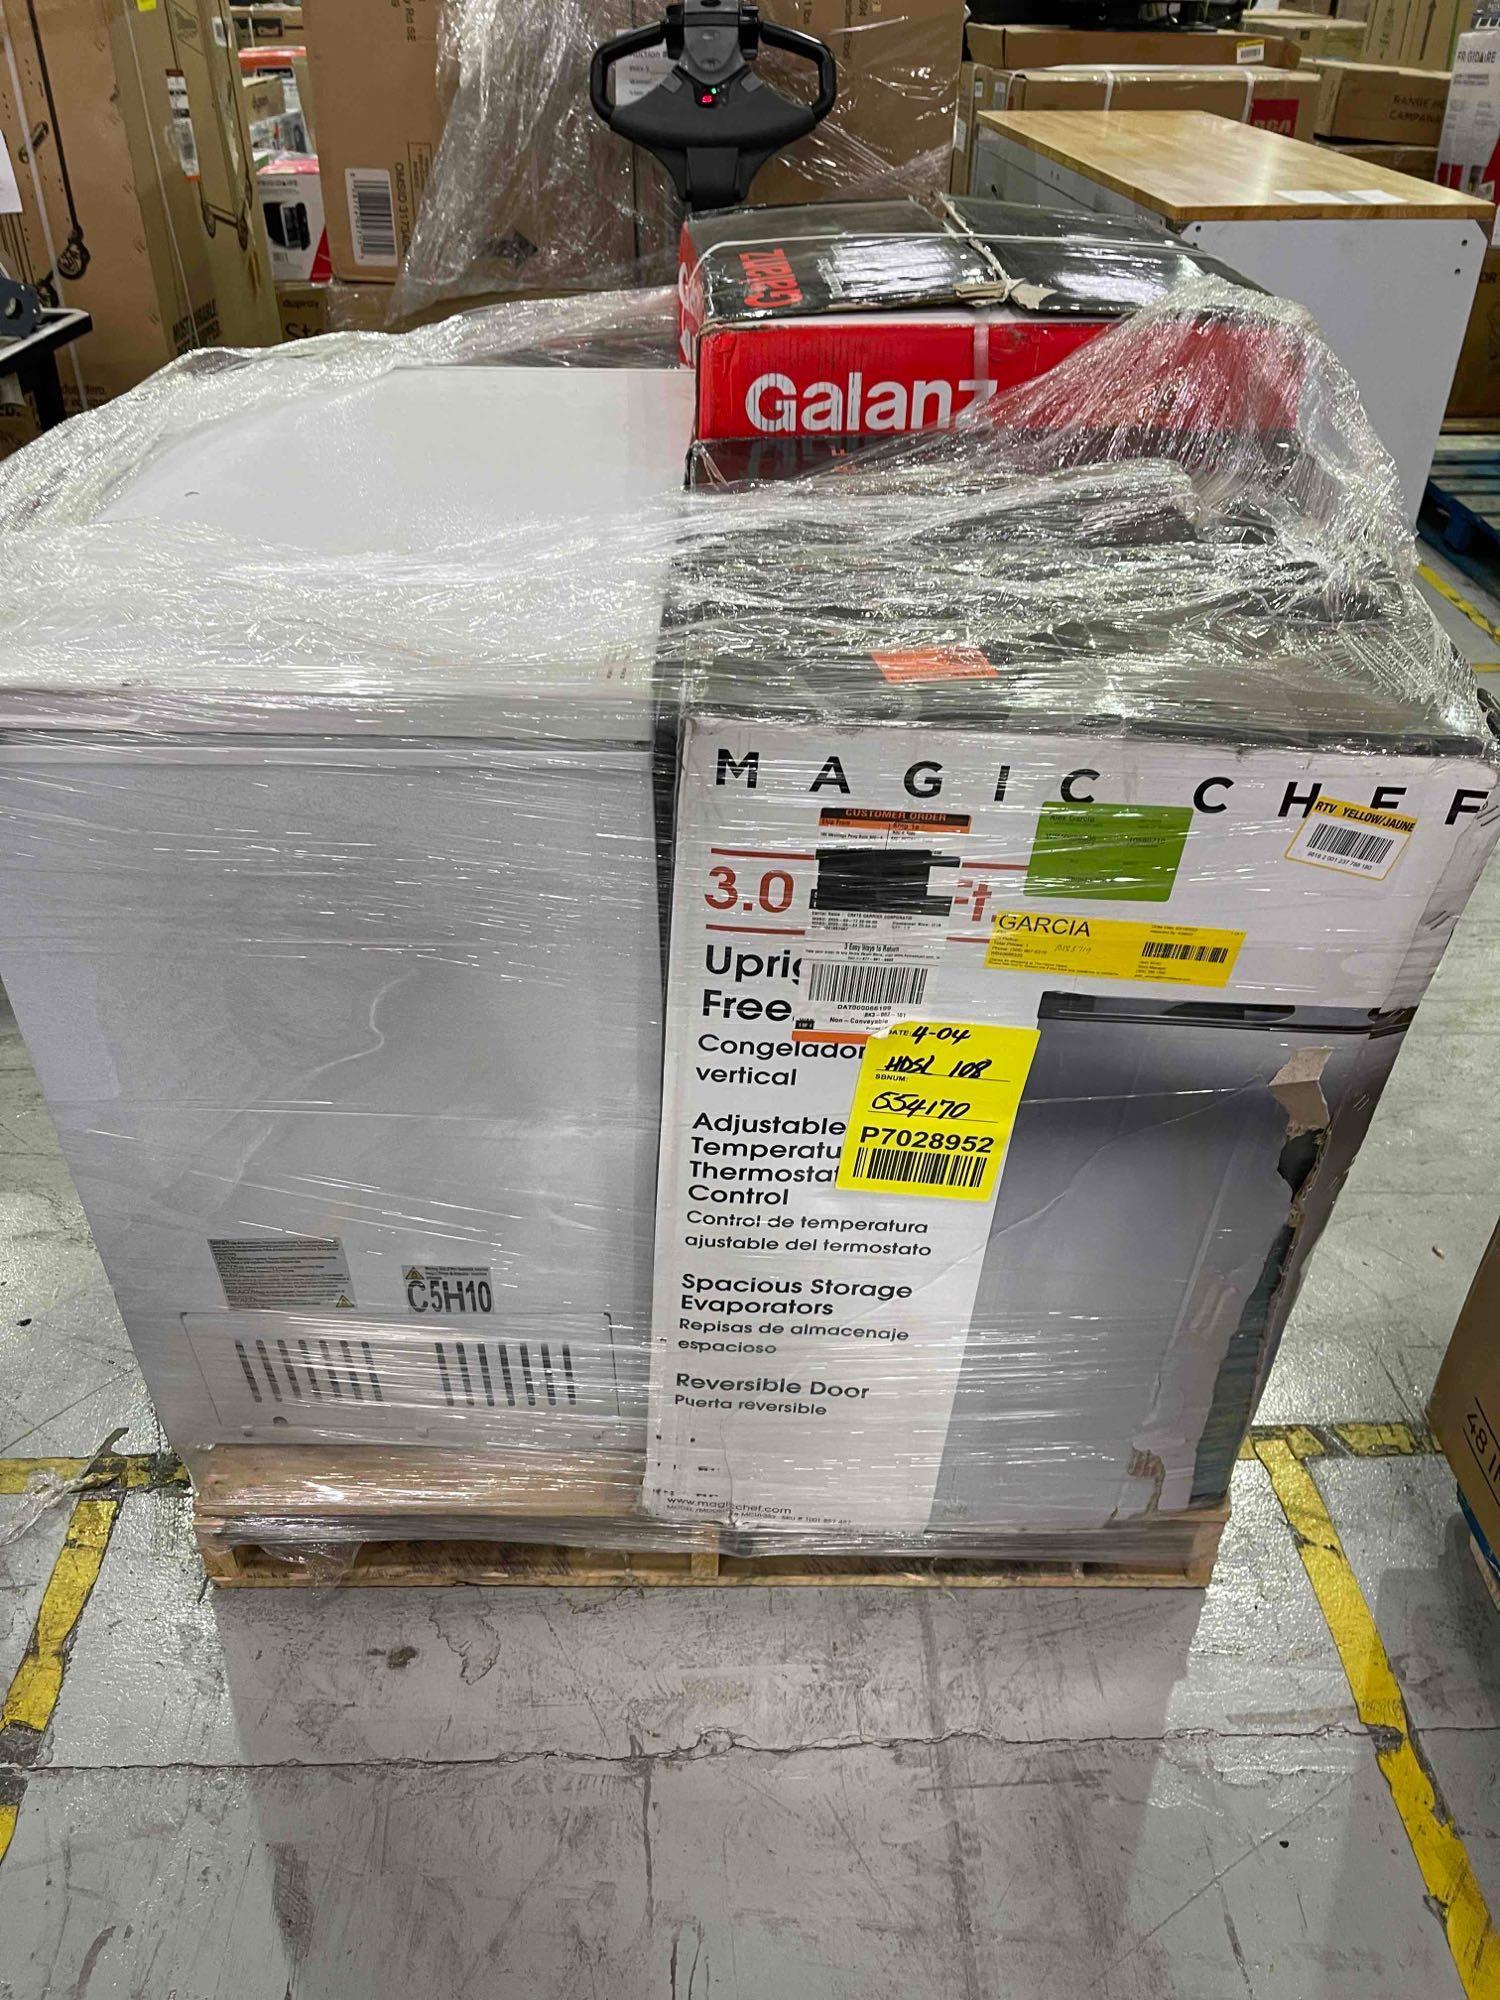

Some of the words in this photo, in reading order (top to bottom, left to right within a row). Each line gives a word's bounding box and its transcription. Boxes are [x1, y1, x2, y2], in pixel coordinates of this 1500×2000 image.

[745, 371, 998, 433] Galanz
[715, 748, 1101, 803] MAGIC
[1193, 776, 1489, 826] CHEF
[845, 809, 906, 820] CUSTOMER
[909, 811, 947, 822] ORDER
[1314, 801, 1338, 814] RTV
[1342, 806, 1415, 832] YELLOW/JAUNE
[704, 866, 795, 914] 3.0
[999, 914, 1091, 937] GARCIA
[697, 1033, 866, 1060] Congelador
[911, 1025, 971, 1045] 4-04
[696, 1066, 797, 1086] vertical
[949, 1058, 993, 1079] 108
[692, 1112, 847, 1136] Adjustable
[859, 1126, 995, 1154] P7028952
[688, 1184, 789, 1206] Control
[686, 1209, 762, 1228] Control
[767, 1215, 795, 1229] de
[800, 1215, 929, 1234] temperatura
[684, 1234, 779, 1251] ajustable
[785, 1238, 817, 1251] del
[823, 1239, 932, 1256] termostato
[407, 1280, 492, 1313] C5H10
[681, 1273, 803, 1294] Spacious
[810, 1278, 913, 1301] Storage
[680, 1294, 834, 1316] Evaporators
[678, 1318, 753, 1335] Repisas
[758, 1322, 785, 1335] de
[790, 1323, 909, 1342] almacenaje
[678, 1339, 777, 1354] espacioso
[675, 1373, 802, 1394] Reversible
[809, 1380, 870, 1400] Door
[674, 1394, 733, 1410] Puerta
[738, 1399, 828, 1416] reversible
